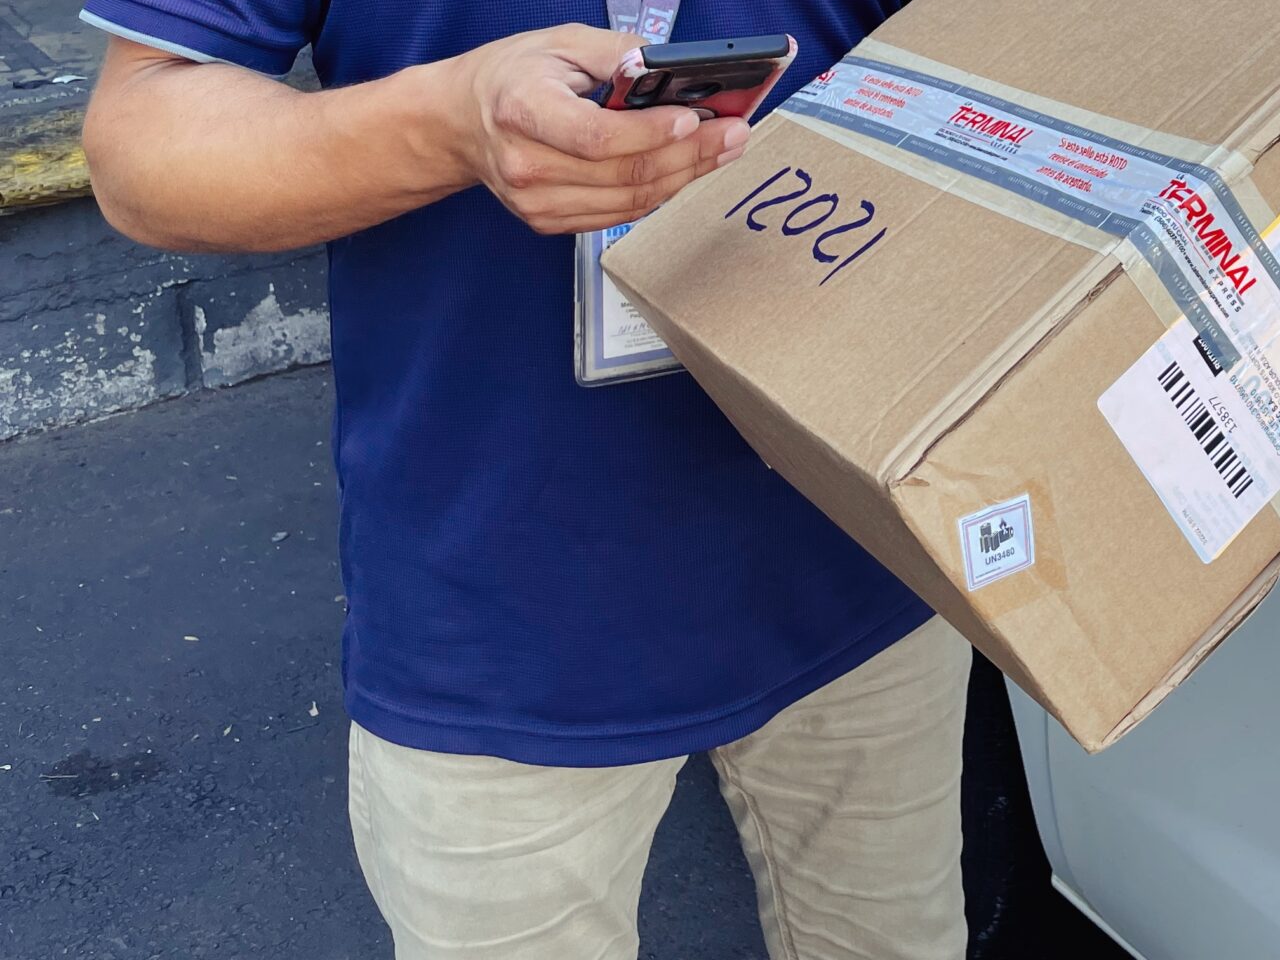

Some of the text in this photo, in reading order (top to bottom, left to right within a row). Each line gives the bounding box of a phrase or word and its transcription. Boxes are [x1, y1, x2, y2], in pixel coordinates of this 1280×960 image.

[946, 105, 1033, 147] TERMINAL
[1066, 142, 1079, 153] este
[1079, 147, 1094, 159] sello
[1108, 155, 1127, 170] ROTO
[1158, 178, 1257, 306] TERMINAL
[1208, 267, 1242, 313] EXPRESS
[1208, 397, 1237, 433] 138577
[984, 546, 1015, 565] UN3480
